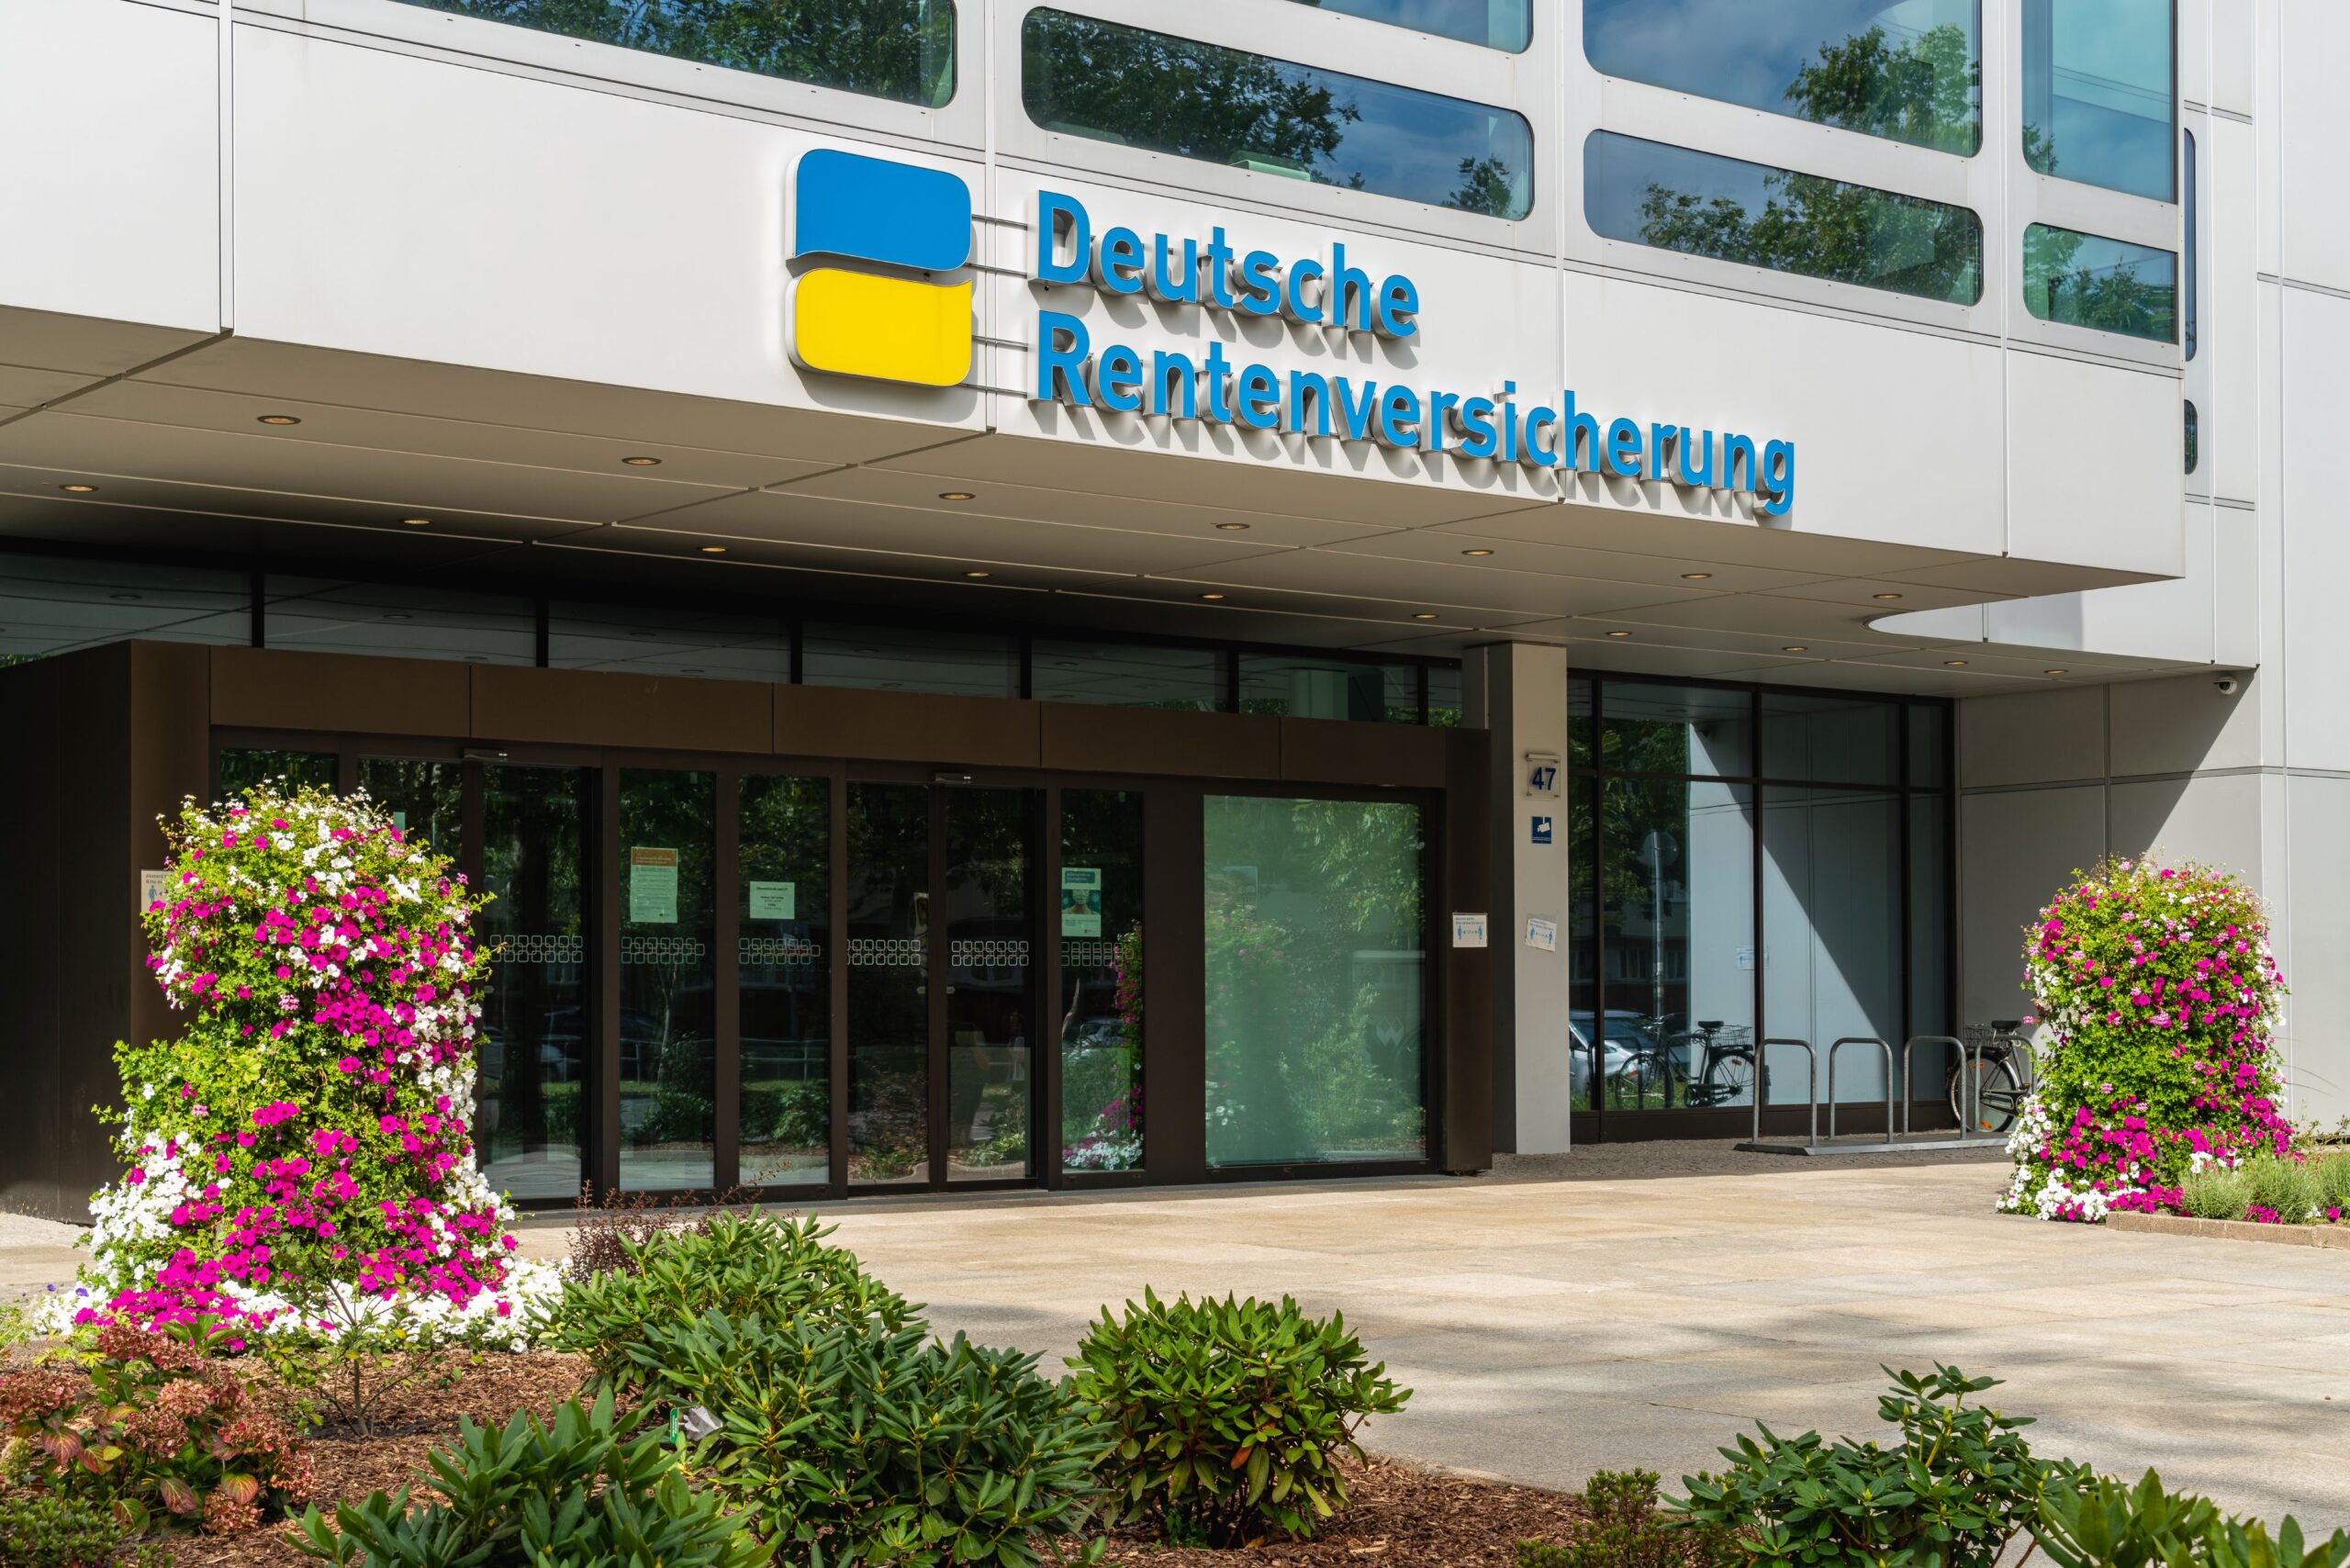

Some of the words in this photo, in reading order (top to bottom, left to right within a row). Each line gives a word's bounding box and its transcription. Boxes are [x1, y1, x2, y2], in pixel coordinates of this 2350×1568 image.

[1038, 190, 1419, 337] Deutsche
[1038, 310, 1795, 516] Rentenversicherung
[1532, 767, 1557, 790] 47
